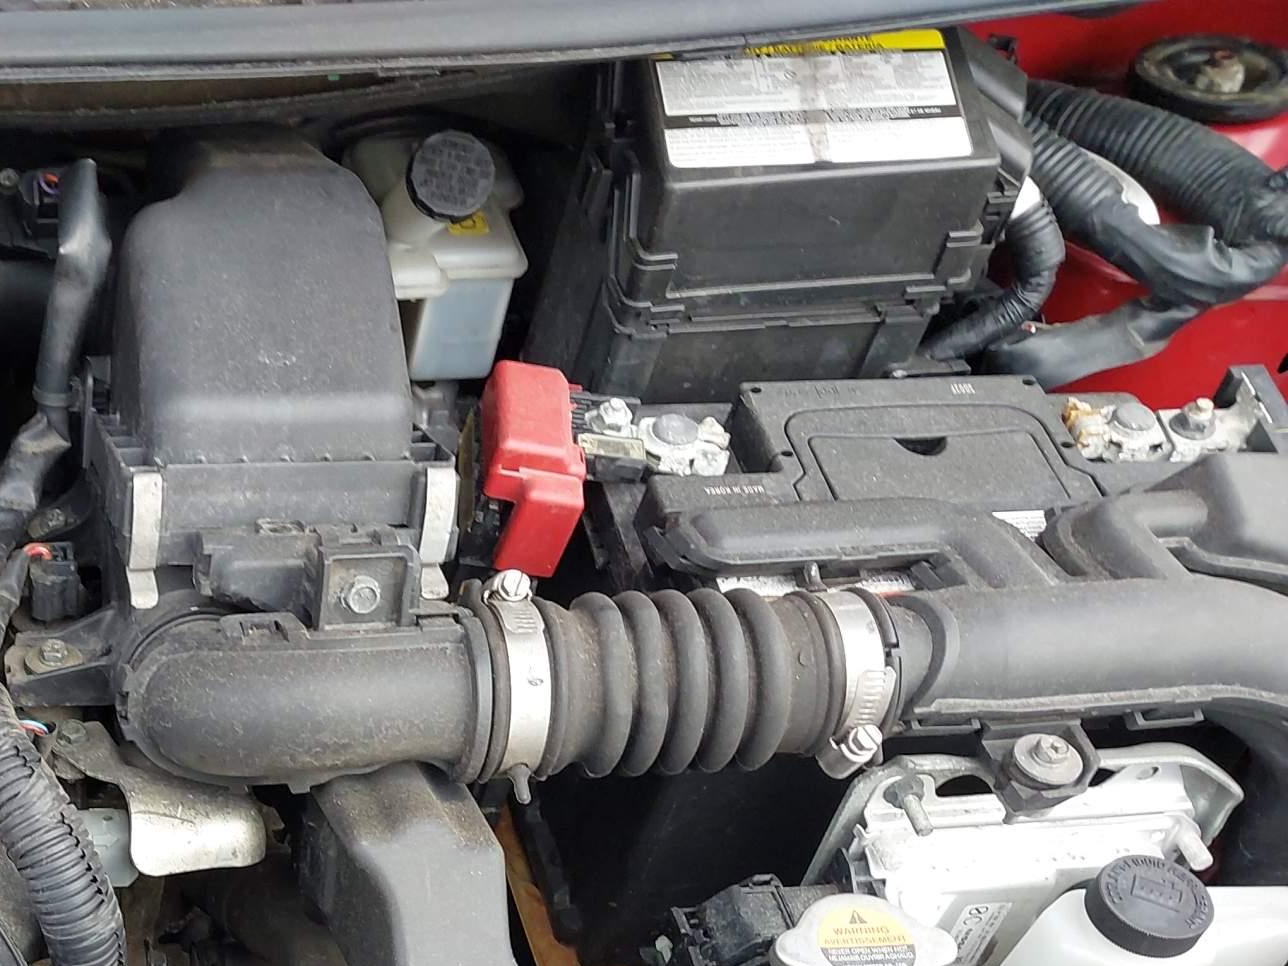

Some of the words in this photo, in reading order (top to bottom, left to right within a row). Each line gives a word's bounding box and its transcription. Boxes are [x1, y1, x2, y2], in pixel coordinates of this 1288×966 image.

[703, 485, 732, 496] KOREA
[832, 926, 890, 936] WARNING
[824, 935, 907, 946] AVERTISSEMENT
